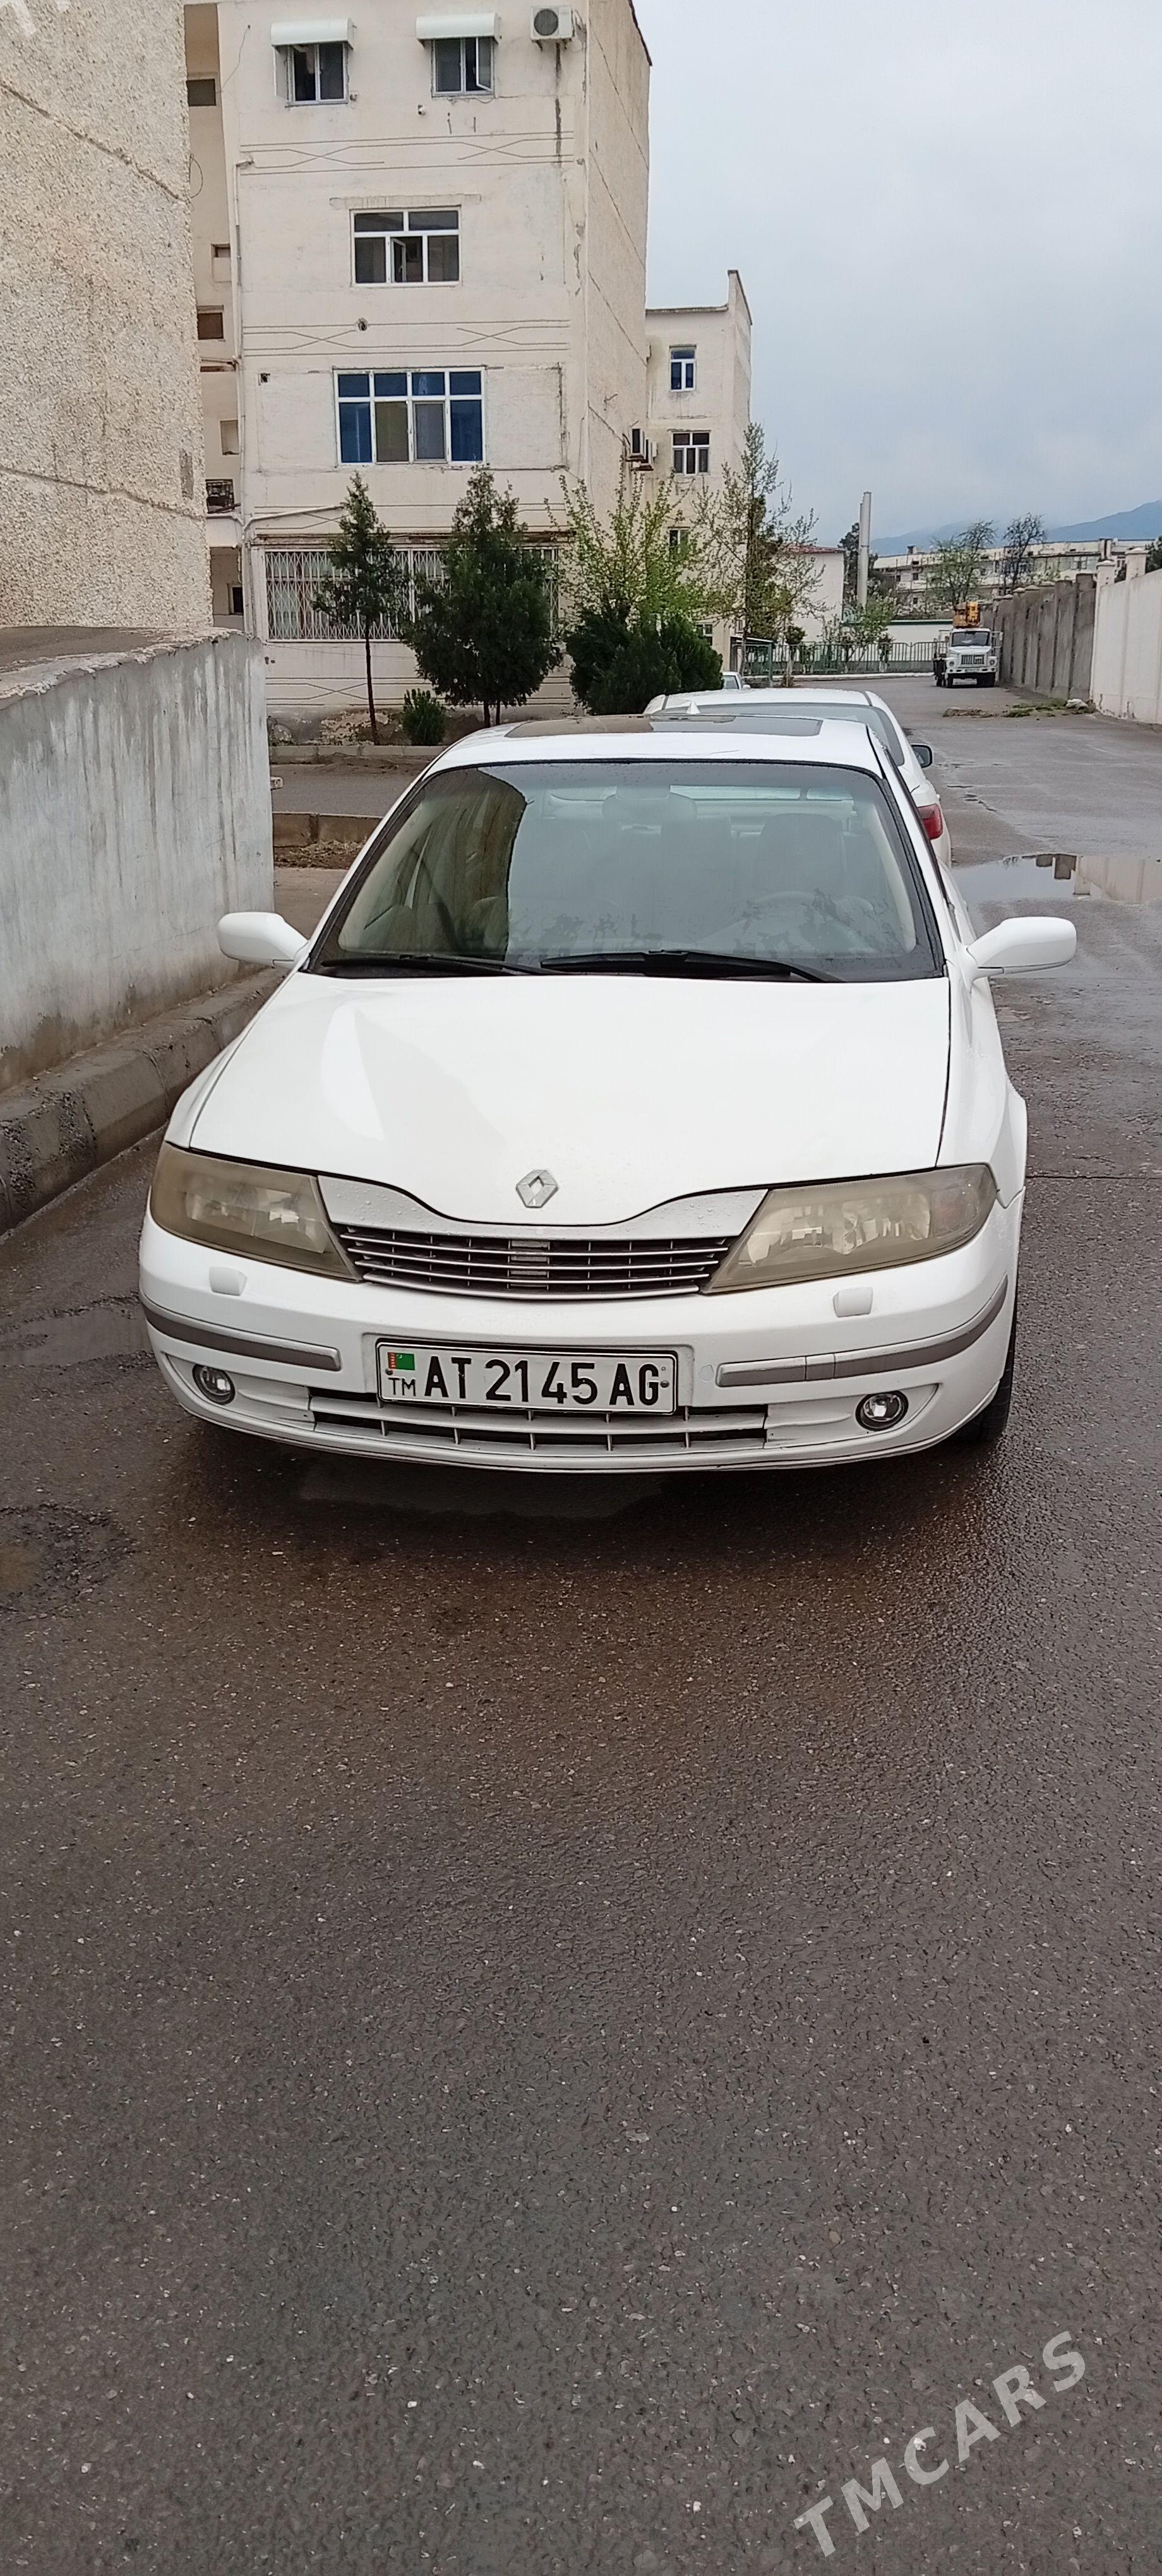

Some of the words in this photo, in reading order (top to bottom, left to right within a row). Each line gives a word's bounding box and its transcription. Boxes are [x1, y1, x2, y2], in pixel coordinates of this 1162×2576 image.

[388, 1376, 416, 1397] TM
[424, 1356, 472, 1399] AT
[484, 1359, 598, 1405] 2145
[609, 1363, 659, 1406] AG
